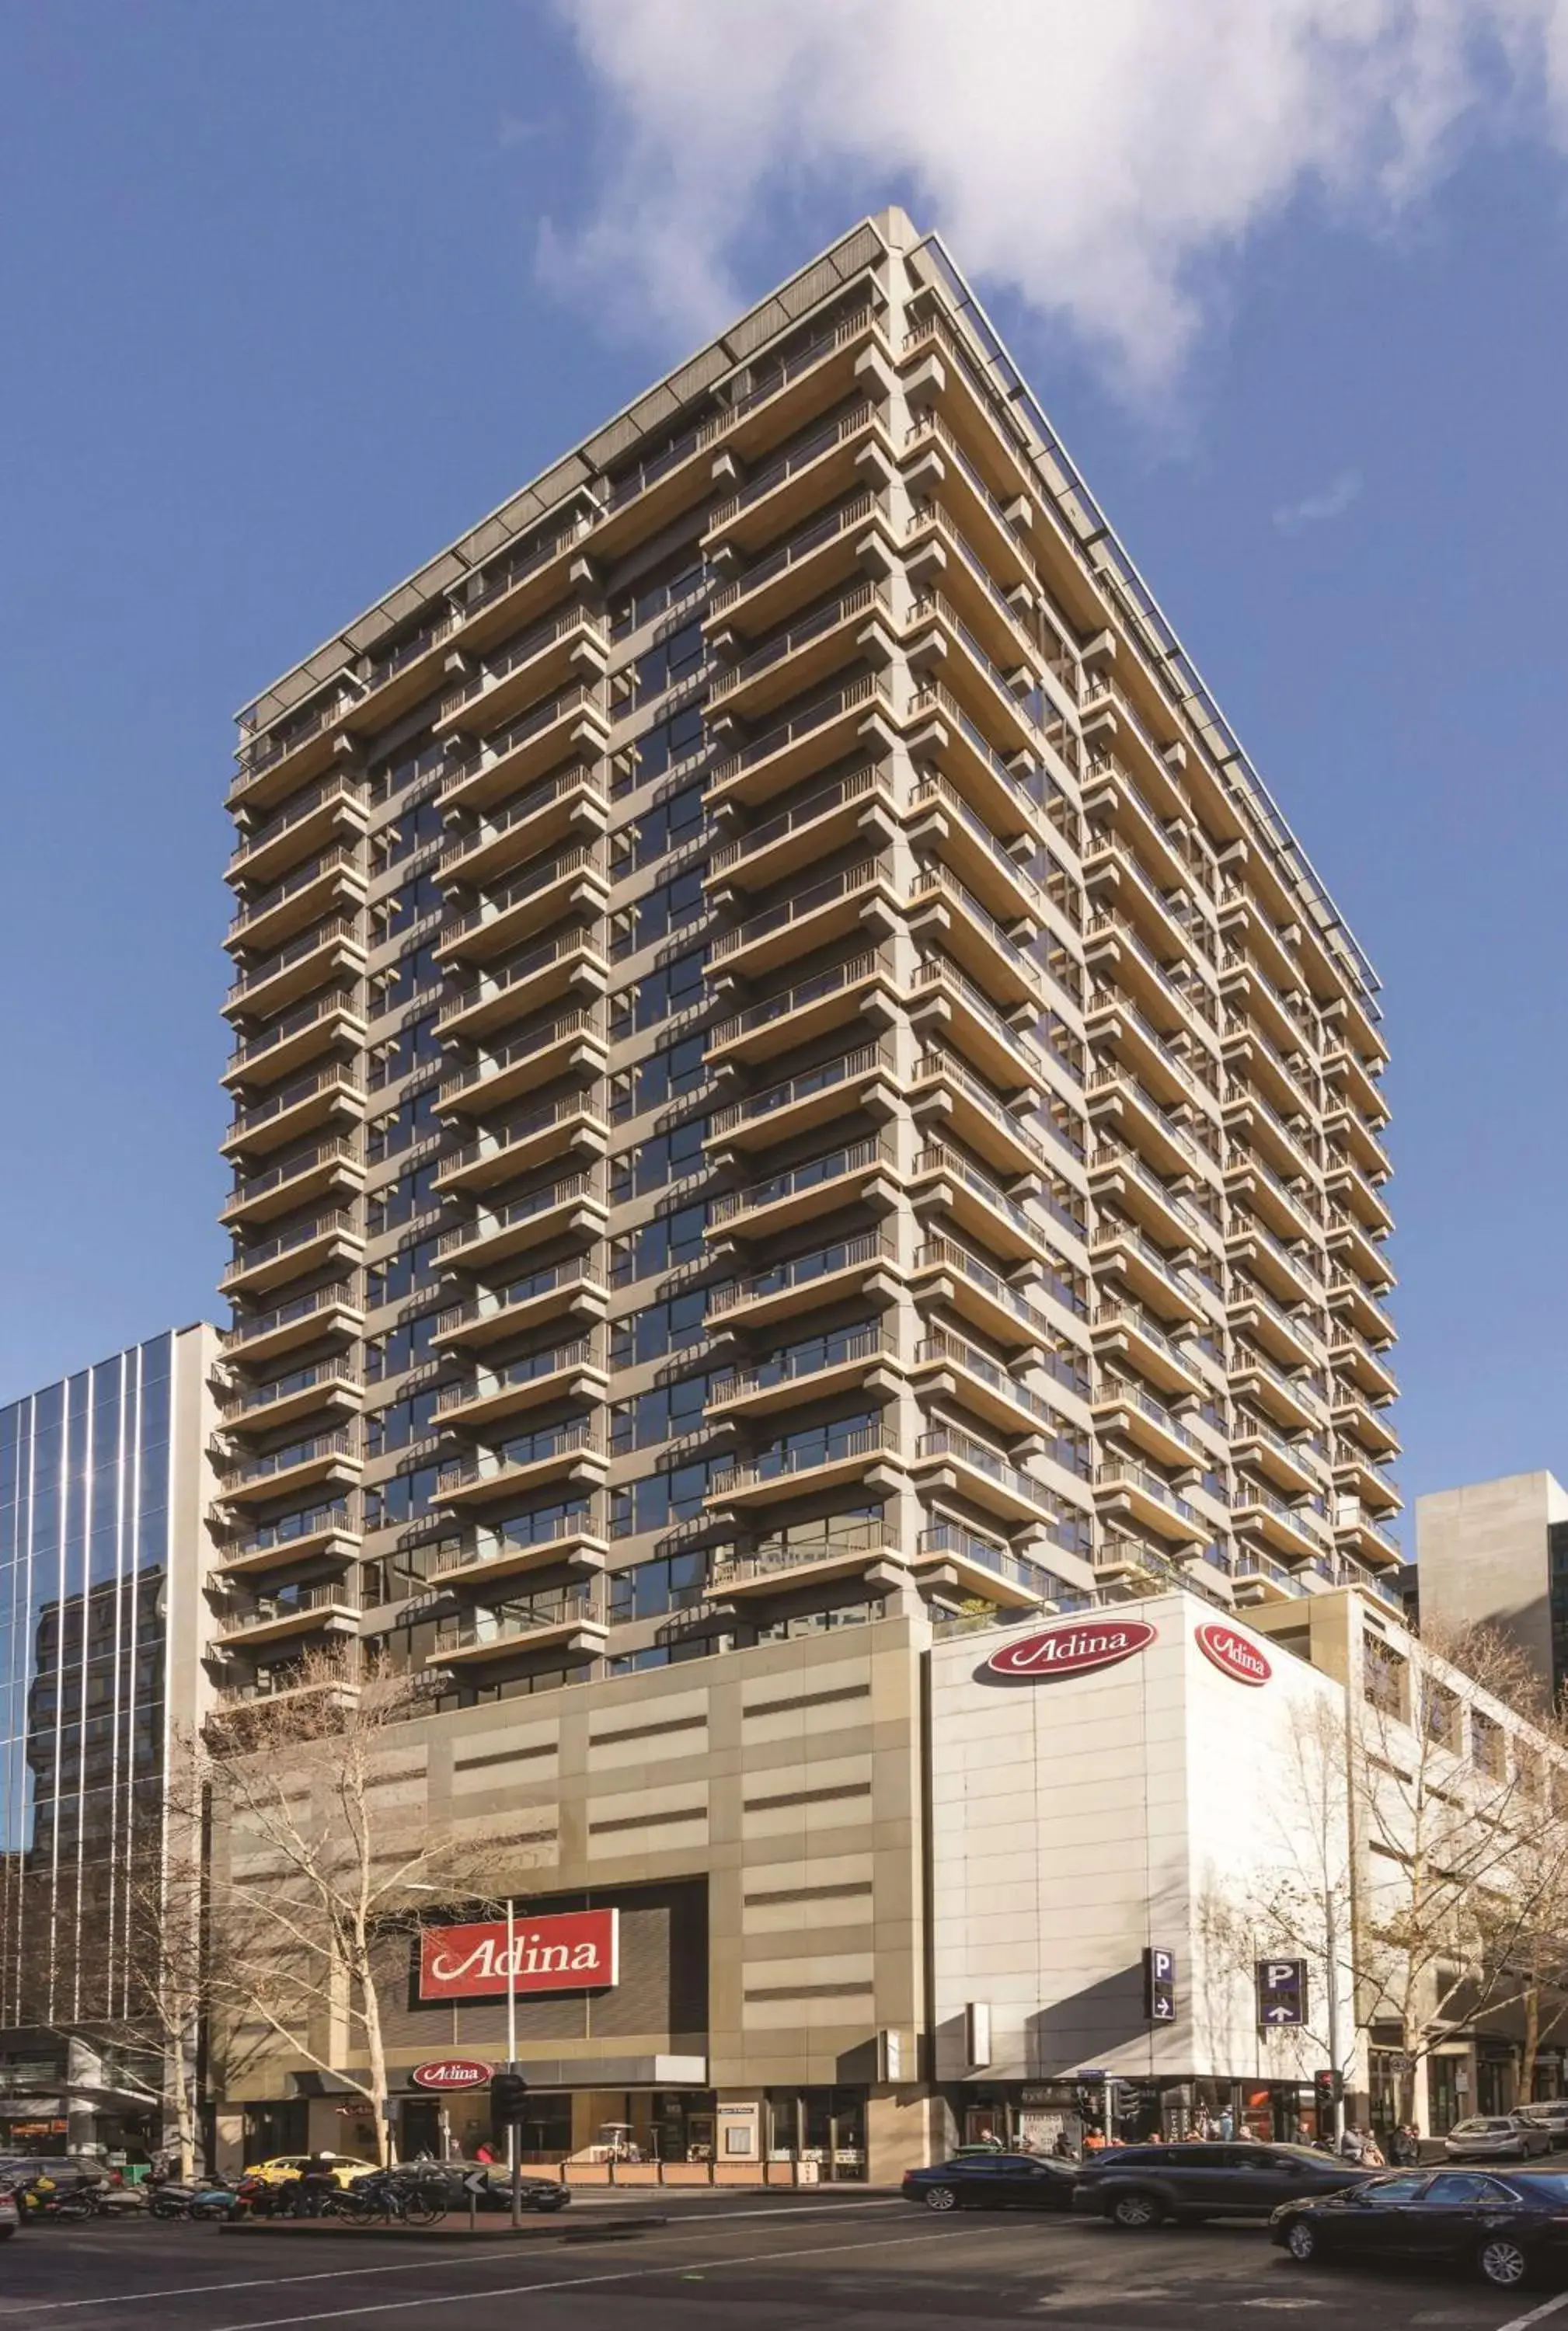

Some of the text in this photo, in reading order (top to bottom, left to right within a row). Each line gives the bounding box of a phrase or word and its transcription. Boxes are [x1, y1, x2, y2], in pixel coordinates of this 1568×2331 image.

[1011, 1631, 1129, 1666] Adina
[1213, 1633, 1266, 1675] Adina
[431, 1933, 600, 1981] Adina
[1155, 1953, 1170, 1978] P
[1267, 1965, 1294, 1989] P
[423, 2064, 479, 2081] Adina
